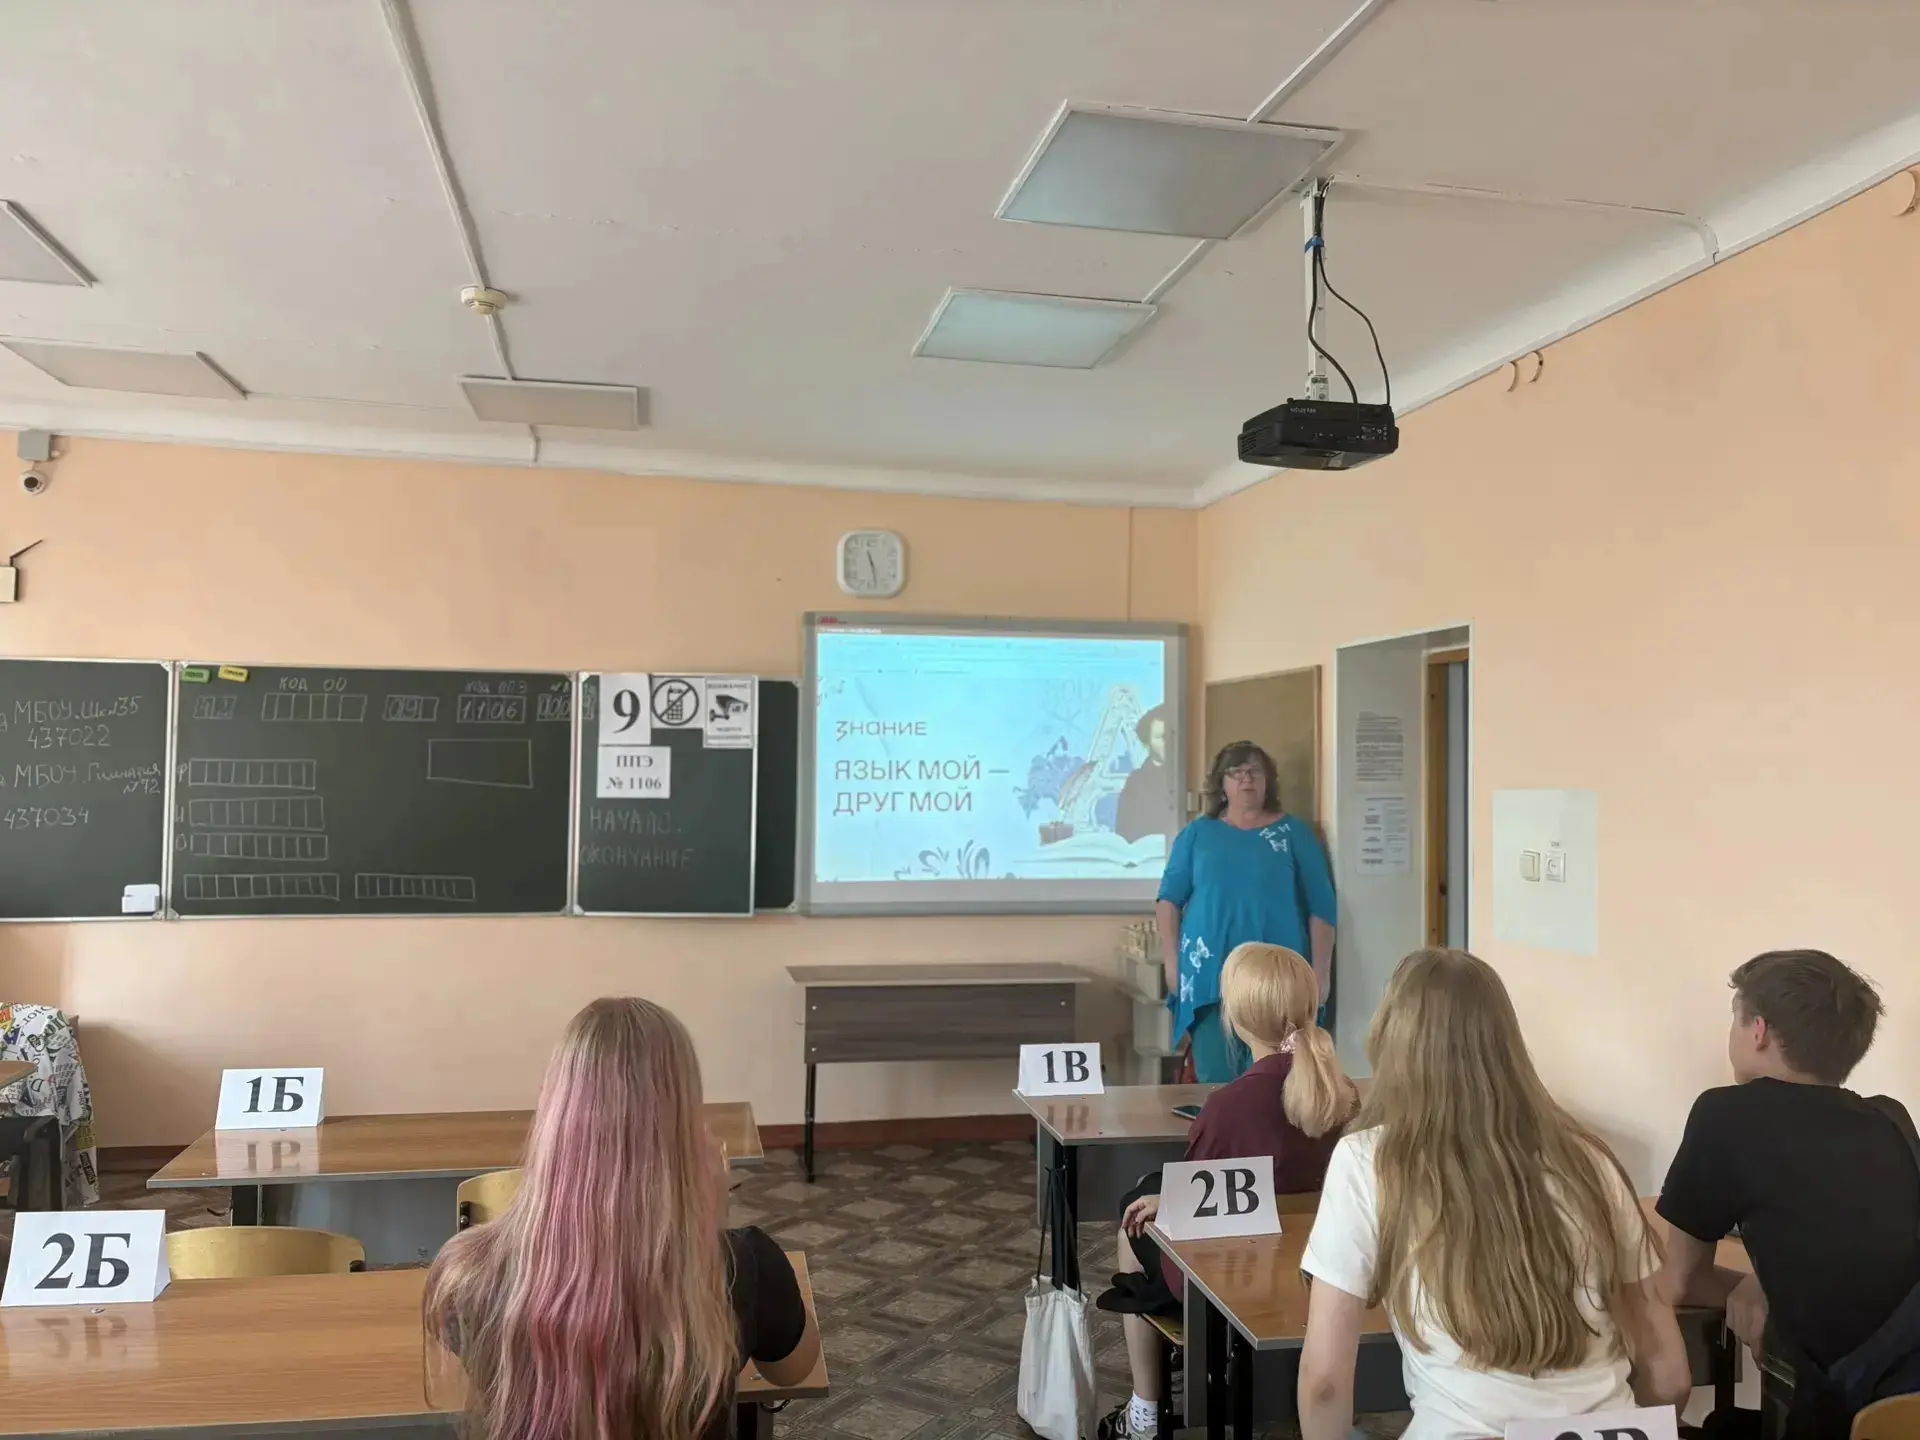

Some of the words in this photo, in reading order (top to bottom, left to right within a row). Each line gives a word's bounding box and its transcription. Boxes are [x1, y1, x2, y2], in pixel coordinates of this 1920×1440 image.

[462, 699, 517, 719] 1106
[613, 689, 640, 733] 9
[28, 724, 110, 749] 437022
[616, 754, 653, 768] ППЭ
[835, 759, 911, 780] ЯЗЫК
[918, 754, 981, 780] МОЙ
[606, 776, 623, 790] №
[629, 776, 662, 790] 1106
[833, 792, 904, 816] ДРУГ
[909, 785, 972, 812] МОЙ
[4, 806, 89, 829] 437034
[1041, 1049, 1090, 1084] 1В
[243, 1076, 305, 1113] 1Б
[1190, 1168, 1260, 1218] 2В
[34, 1233, 131, 1290] 2Б
